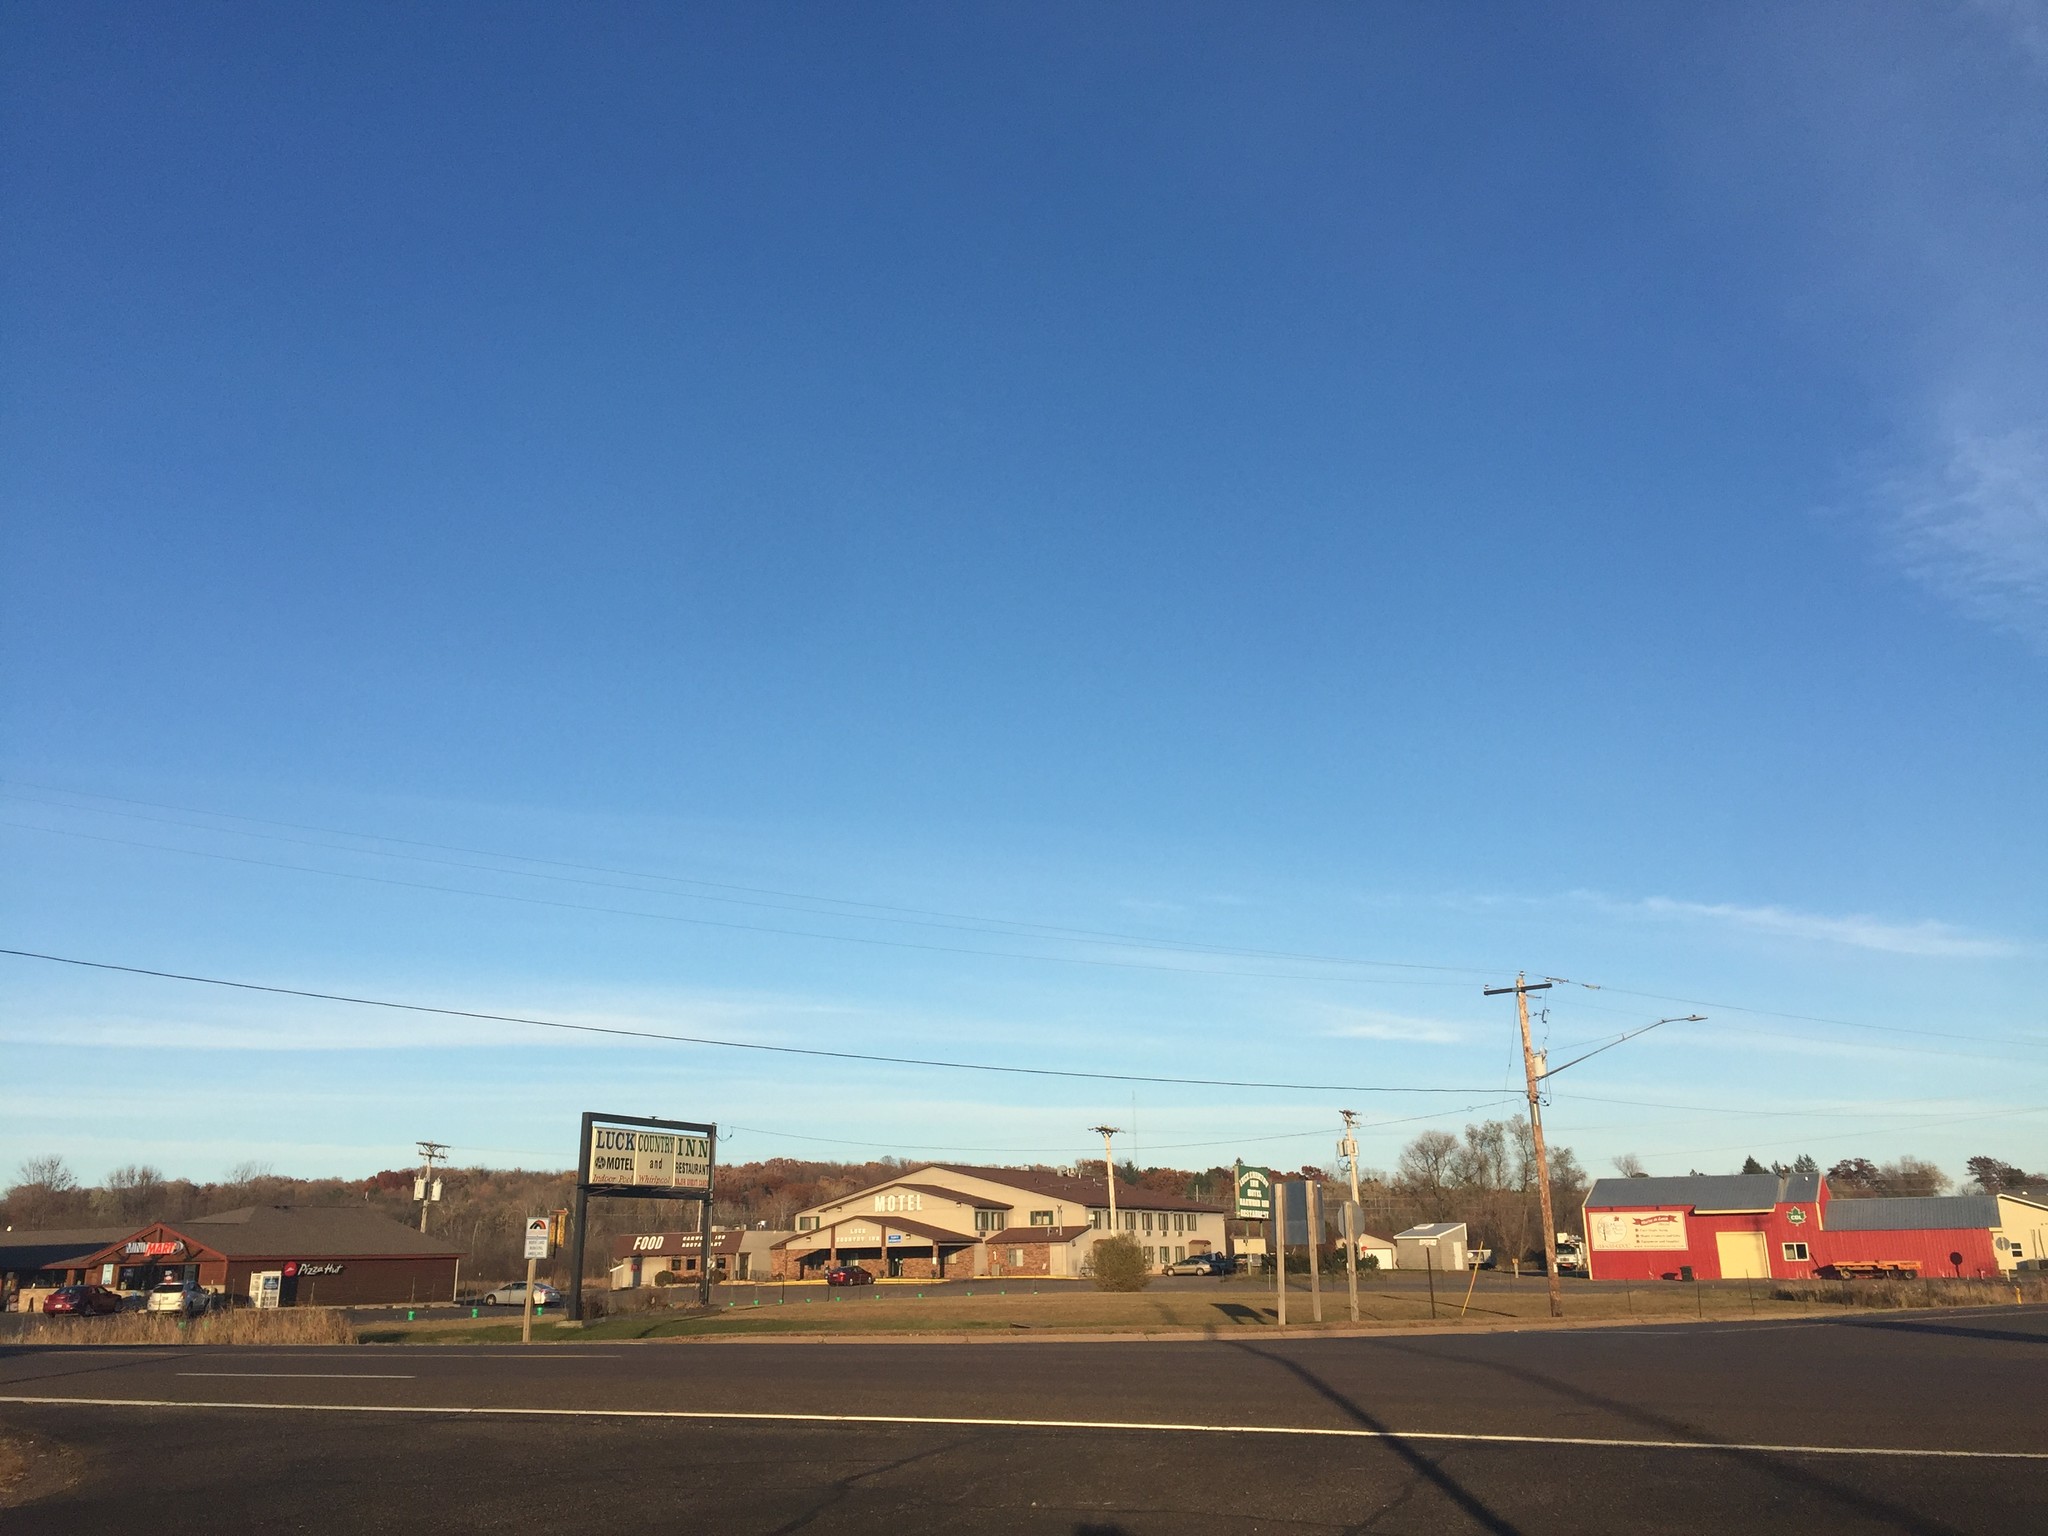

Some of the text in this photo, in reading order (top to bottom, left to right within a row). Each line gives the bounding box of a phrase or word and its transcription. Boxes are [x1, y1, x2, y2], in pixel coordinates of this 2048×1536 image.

[596, 1130, 709, 1159] LUCK COUNTRY INN
[606, 1156, 634, 1171] MOTEL
[650, 1158, 663, 1170] and
[675, 1161, 709, 1175] RESTAURANT
[593, 1173, 616, 1183] Indoor
[639, 1174, 671, 1185] Whirlpool
[875, 1194, 923, 1212] MOTEL
[144, 1241, 177, 1257] MART
[633, 1236, 664, 1251] FOOD
[298, 1263, 343, 1275] Pizza Hut
